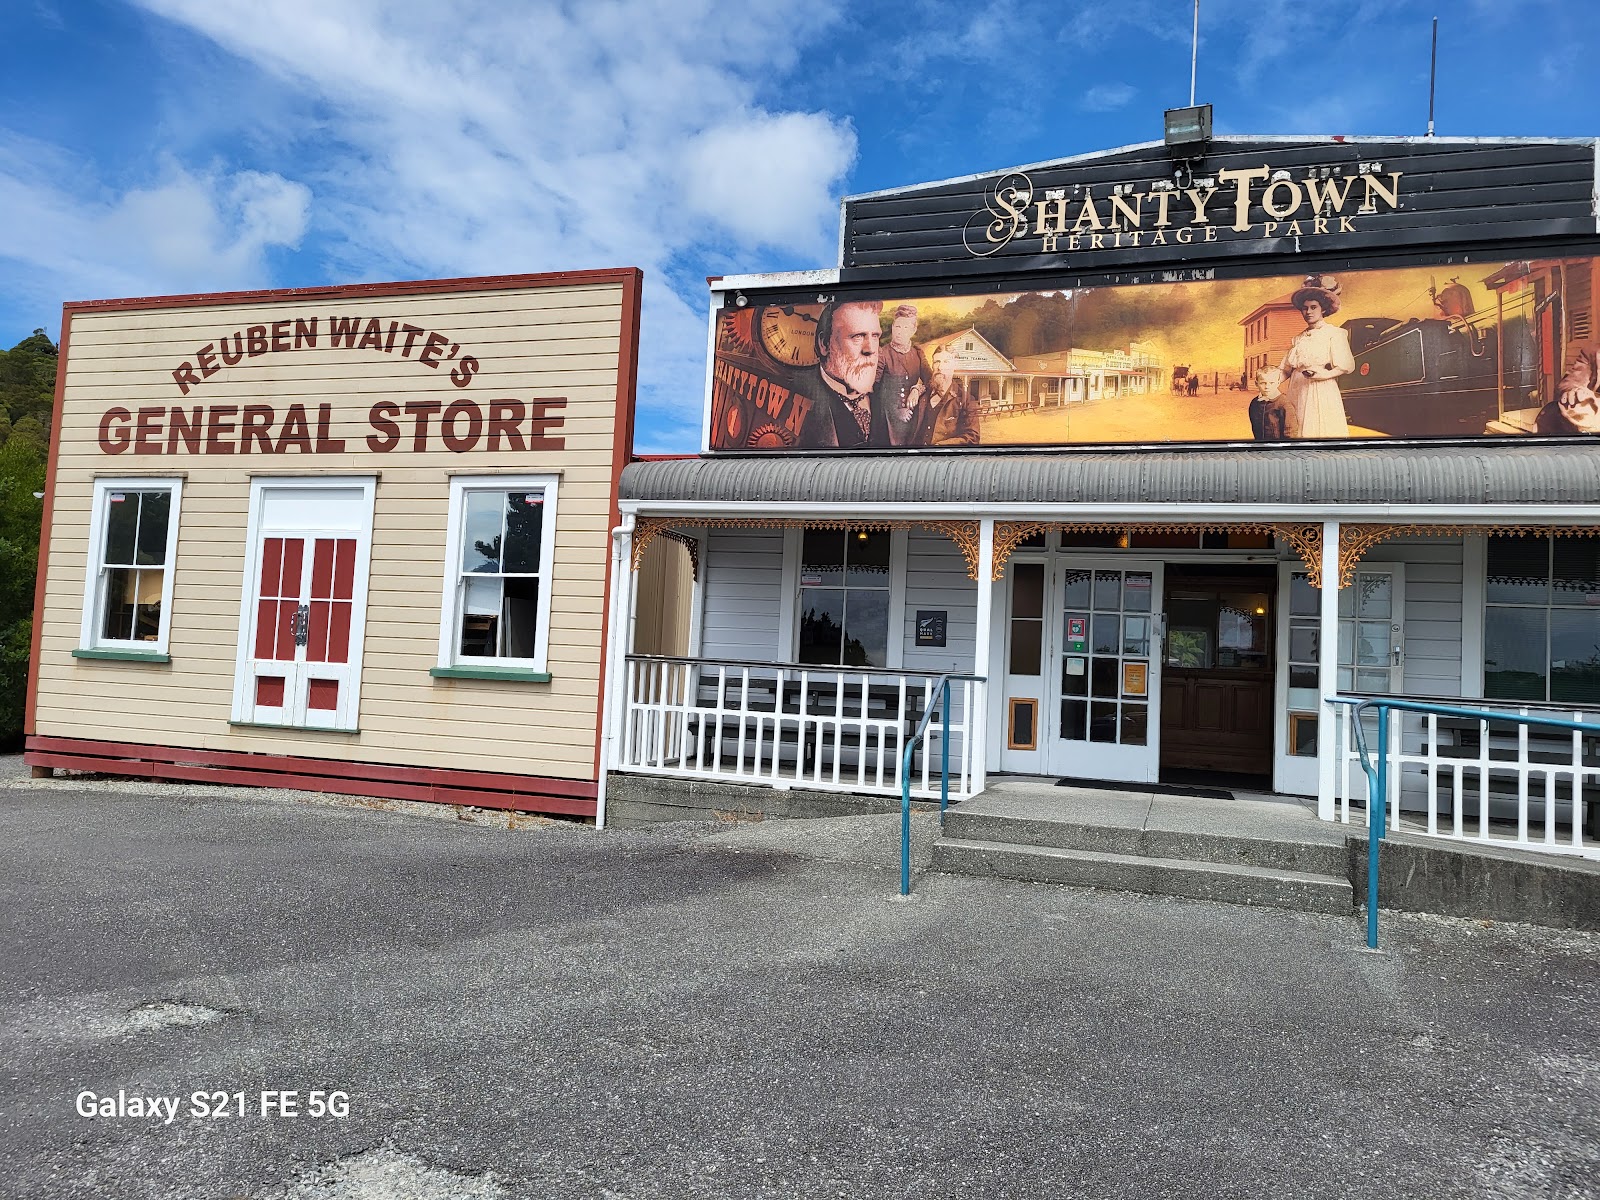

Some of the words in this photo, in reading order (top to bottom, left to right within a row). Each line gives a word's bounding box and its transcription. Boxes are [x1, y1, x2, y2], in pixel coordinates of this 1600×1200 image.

[1041, 225, 1218, 253] HERITAGE
[1263, 215, 1357, 239] PARK
[172, 316, 318, 396] REUBEN
[329, 315, 480, 388] WAITE'S
[98, 403, 345, 456] GENERAL
[366, 396, 568, 454] STORE
